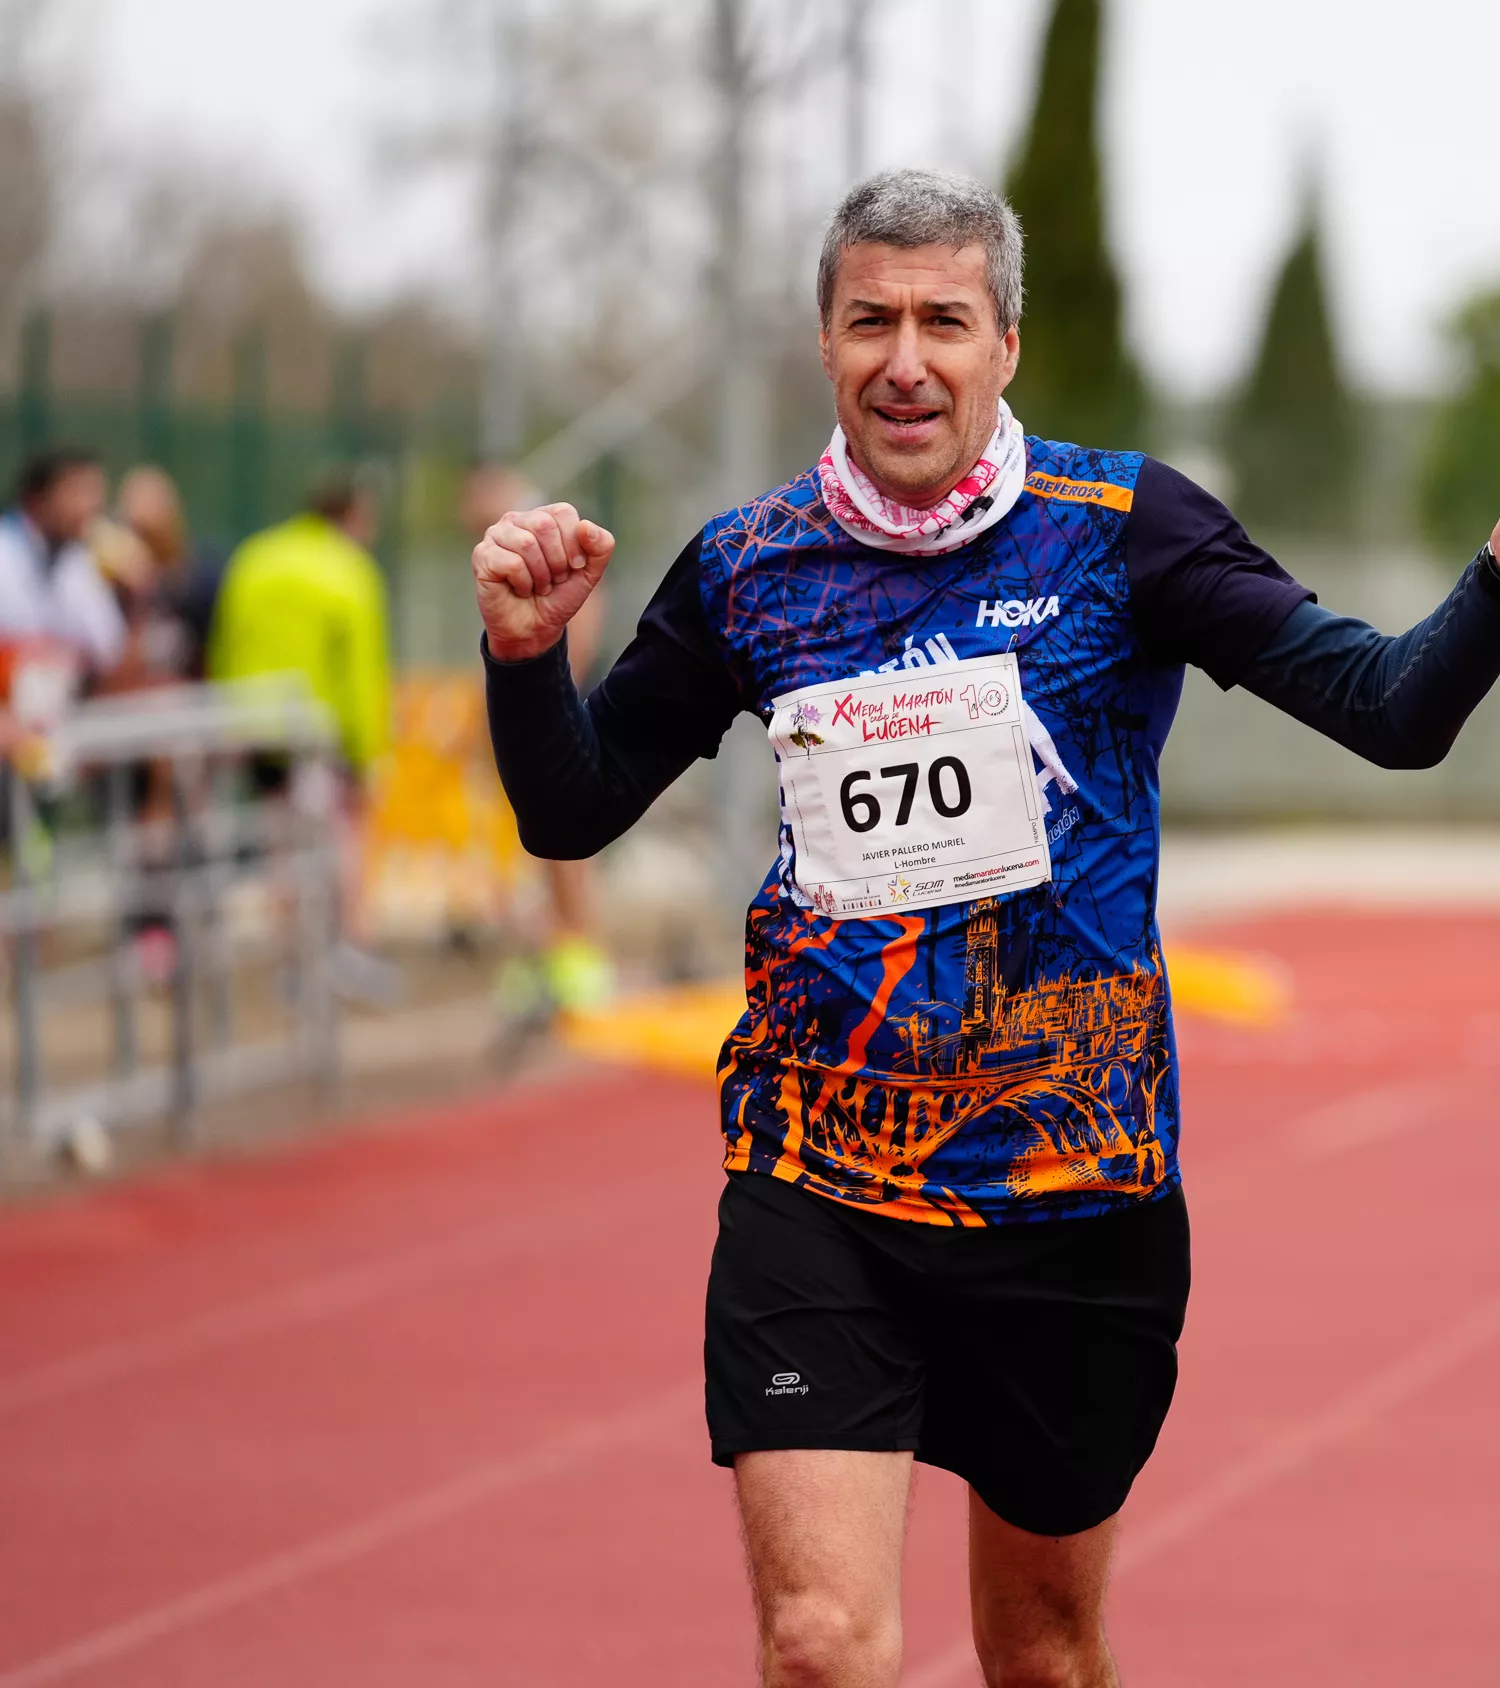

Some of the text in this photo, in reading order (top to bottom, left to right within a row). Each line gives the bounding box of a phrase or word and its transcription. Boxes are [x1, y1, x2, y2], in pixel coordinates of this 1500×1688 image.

[975, 595, 1060, 627] HOKA
[862, 714, 942, 742] LUCENA
[840, 756, 972, 833] 670
[862, 837, 965, 862] JAVIER PALLERO MURIEL
[894, 856, 936, 869] L-Hombre
[953, 859, 1040, 882] mediamaratonlucena.com
[765, 1384, 809, 1397] Kalenji
